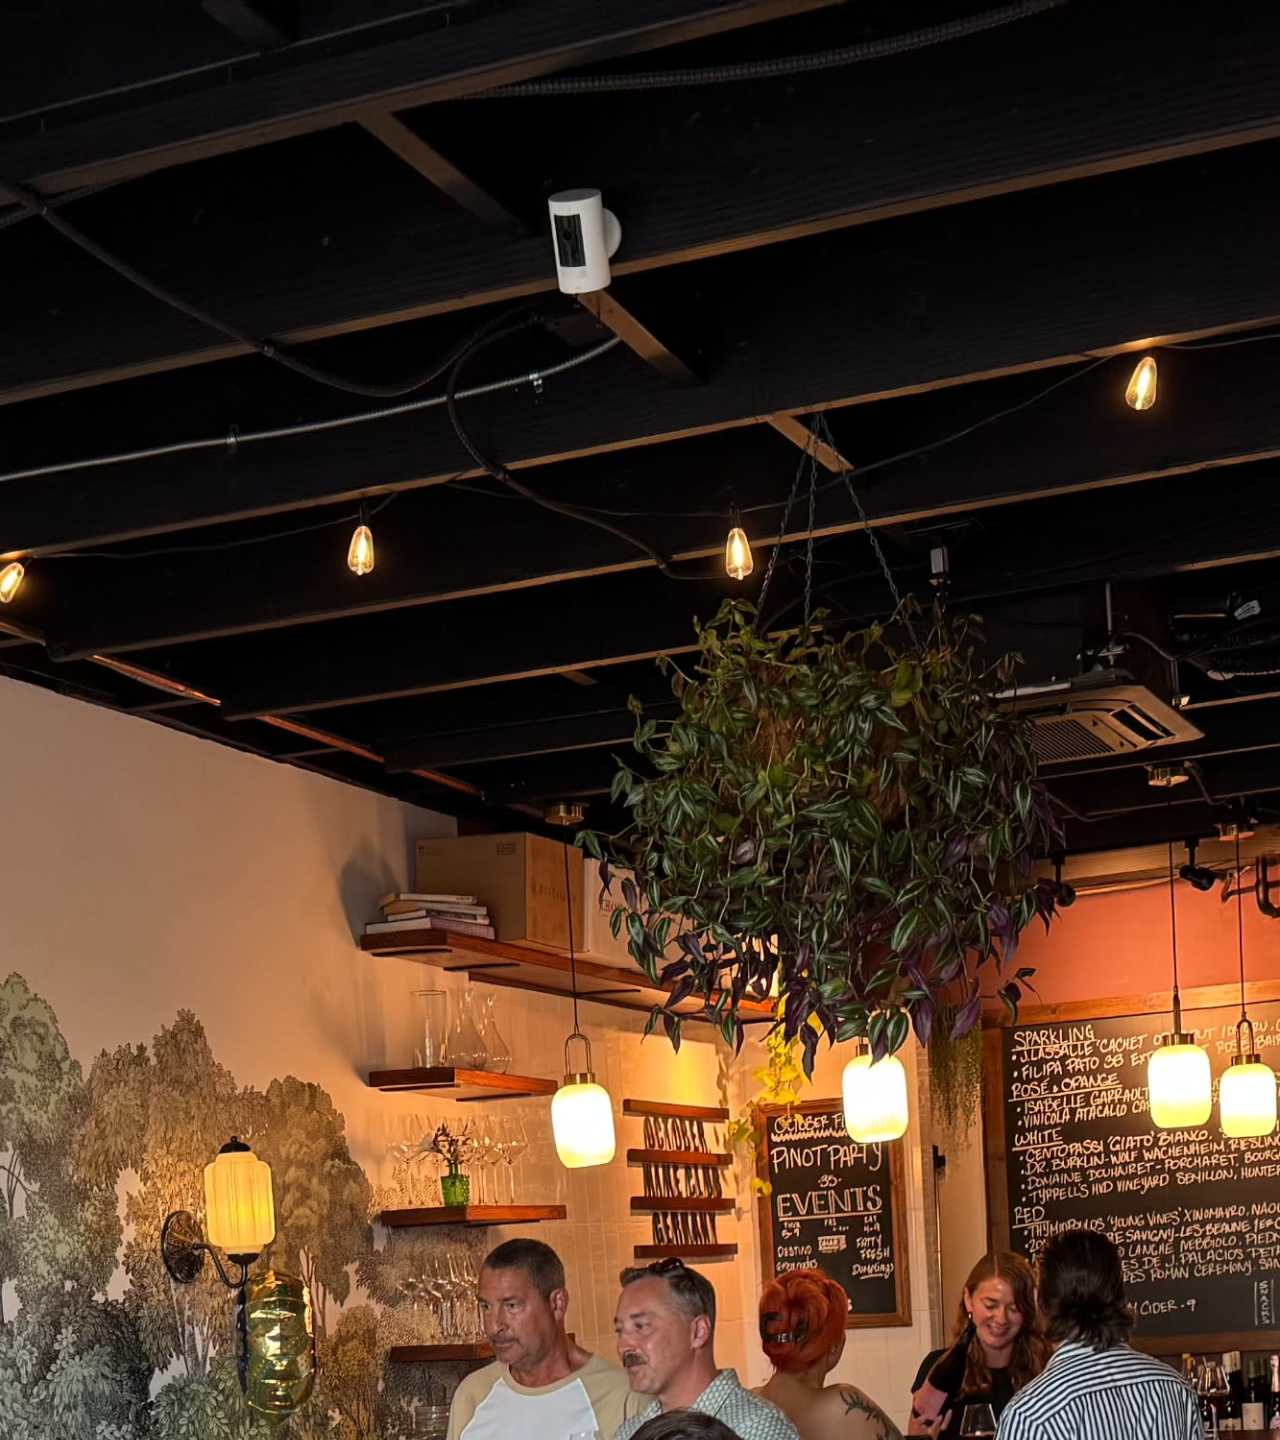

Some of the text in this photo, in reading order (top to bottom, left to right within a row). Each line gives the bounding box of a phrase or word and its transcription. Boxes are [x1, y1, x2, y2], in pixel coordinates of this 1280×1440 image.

[1014, 1025, 1095, 1049] SPARKLING
[1022, 1062, 1062, 1081] FILIPA
[1066, 1057, 1099, 1073] PATO
[1061, 1072, 1120, 1091] ORANGE
[1024, 1095, 1085, 1114] ISABELLE
[1023, 1110, 1070, 1128] VINICOLA
[1014, 1128, 1063, 1146] WHITE
[771, 1143, 881, 1173] PINOT PARTY
[777, 1185, 882, 1216] EVENTS
[1014, 1206, 1045, 1225] RED
[652, 1212, 718, 1246] GERMANY
[1140, 1300, 1177, 1315] CIDER
